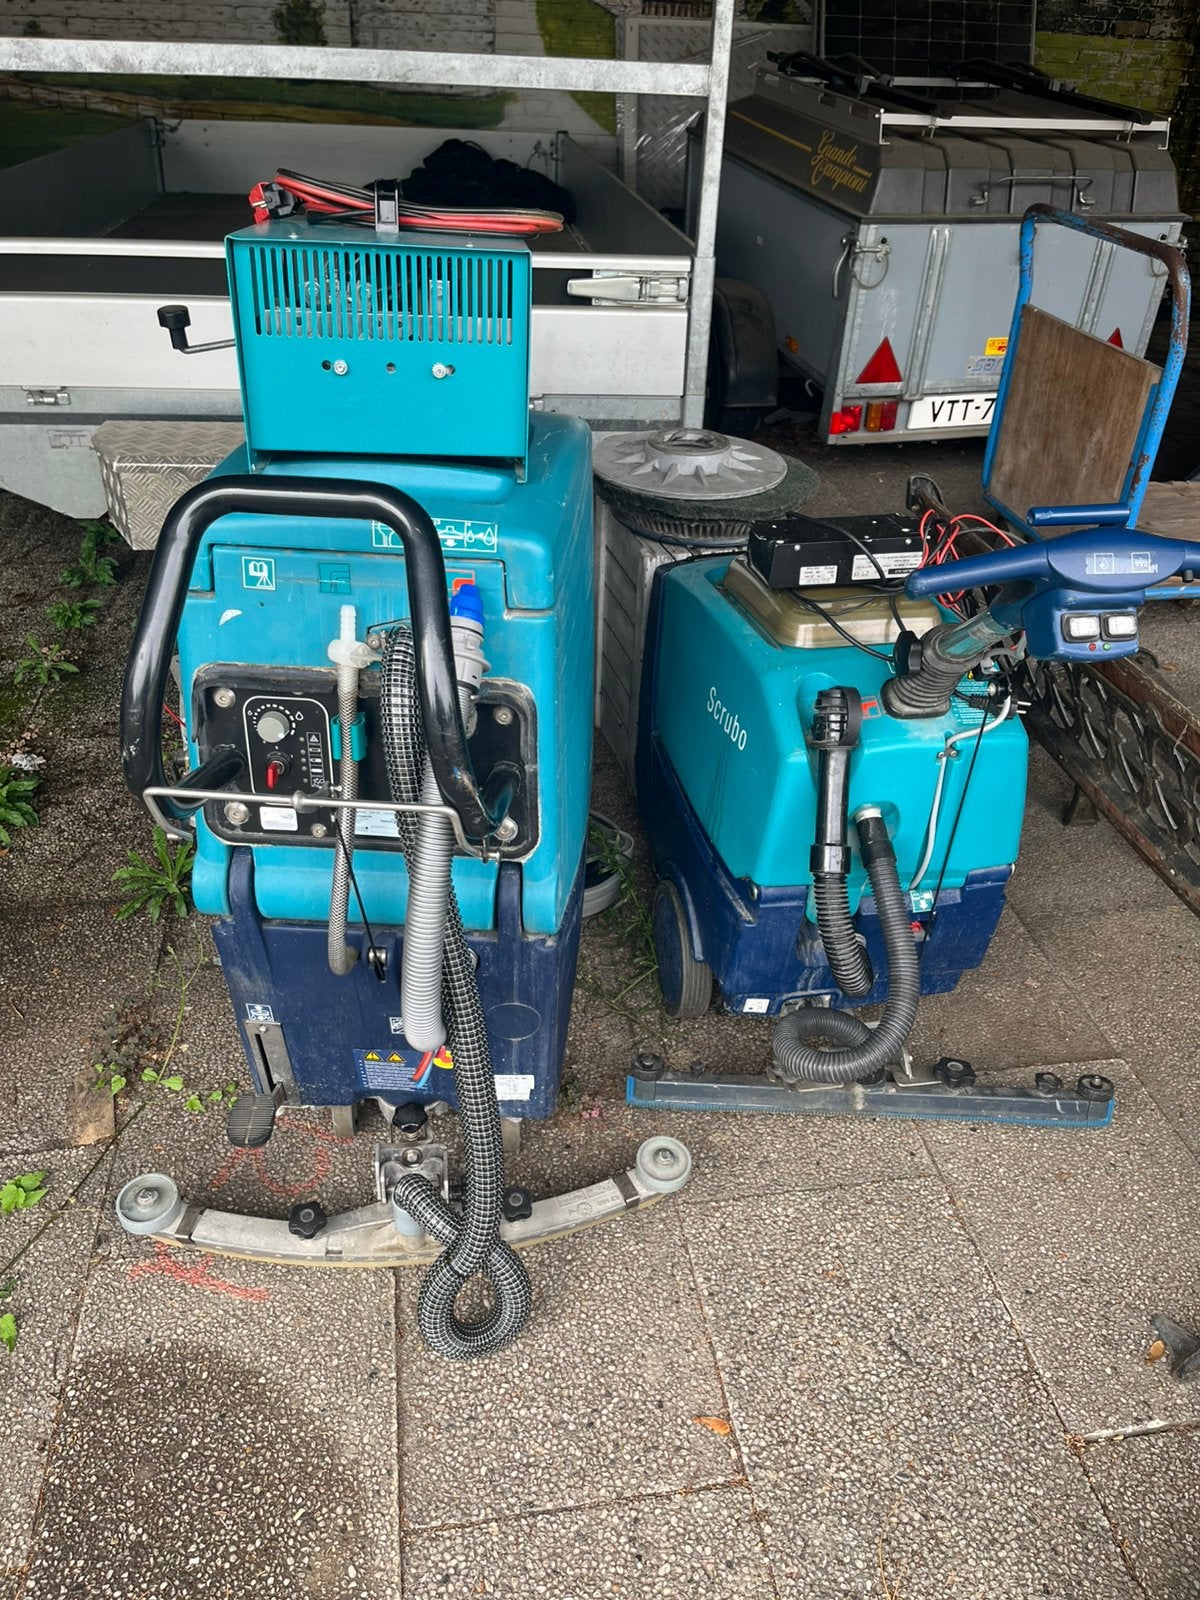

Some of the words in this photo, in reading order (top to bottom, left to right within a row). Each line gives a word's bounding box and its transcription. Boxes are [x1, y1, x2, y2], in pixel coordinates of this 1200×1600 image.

[811, 130, 858, 168] Grande
[931, 398, 997, 422] VTT-7
[707, 686, 747, 751] Scrubo
